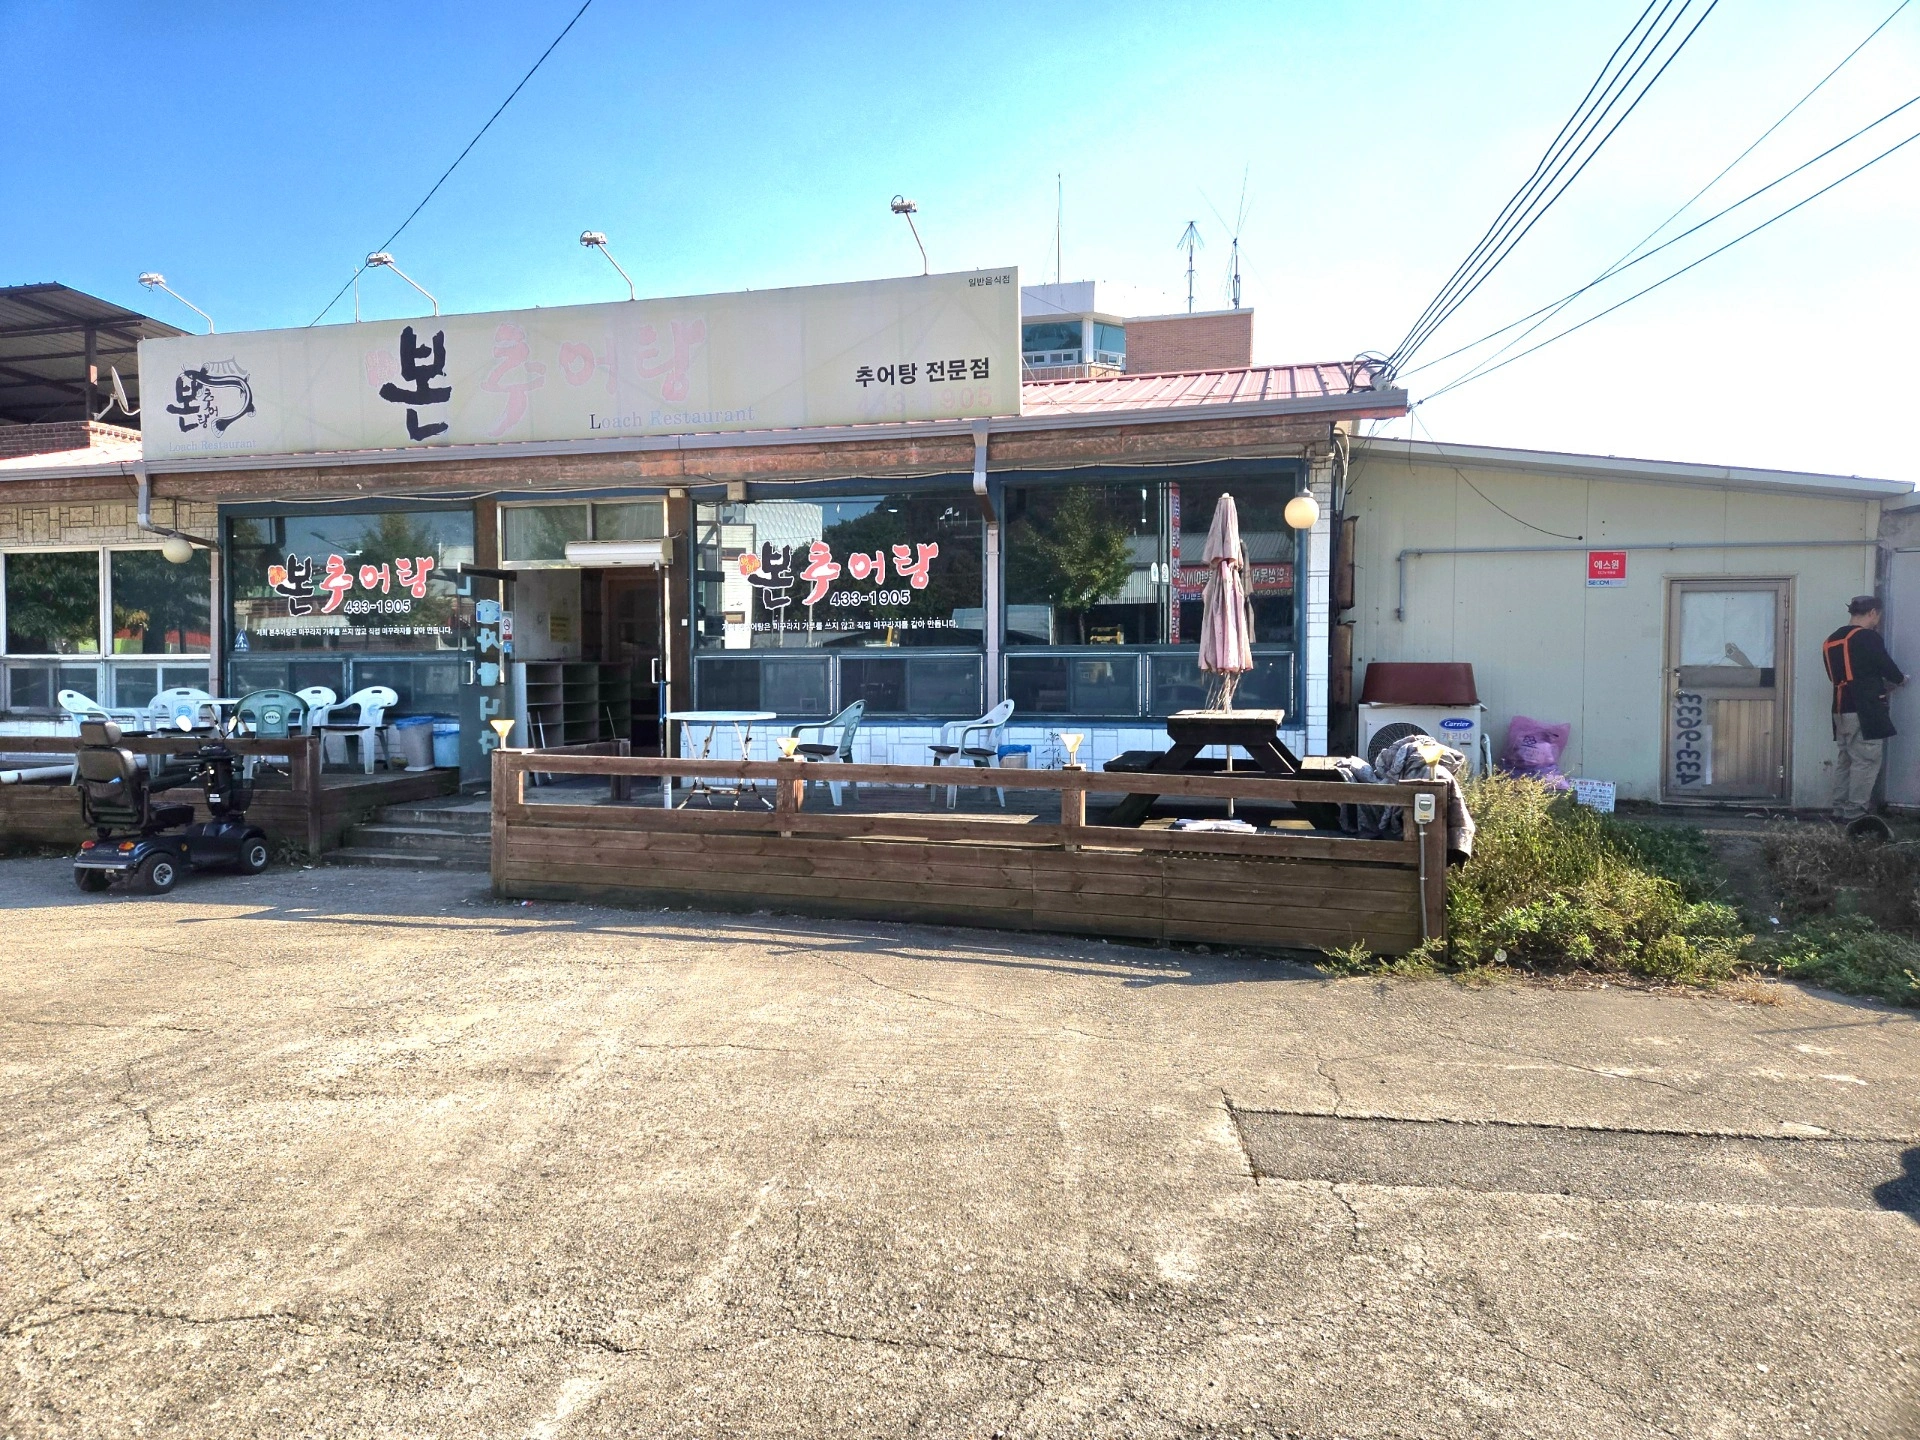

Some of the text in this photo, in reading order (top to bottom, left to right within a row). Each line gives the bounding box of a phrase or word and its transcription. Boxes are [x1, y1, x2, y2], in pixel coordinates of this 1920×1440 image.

[968, 274, 1010, 288] 일반음식점
[855, 357, 989, 387] 추어탕 전문점
[589, 405, 755, 431] Loach Restaurant
[201, 439, 257, 451] Restaurant
[1593, 559, 1620, 570] 에스원
[748, 541, 939, 610] 본추어탕
[275, 553, 434, 617] 본추어탕
[344, 598, 412, 615] 433-1905
[829, 589, 911, 607] 433-1905
[773, 621, 800, 631] 미꾸라지
[825, 621, 839, 631] 쓰지
[873, 620, 908, 630] 미꾸라지를
